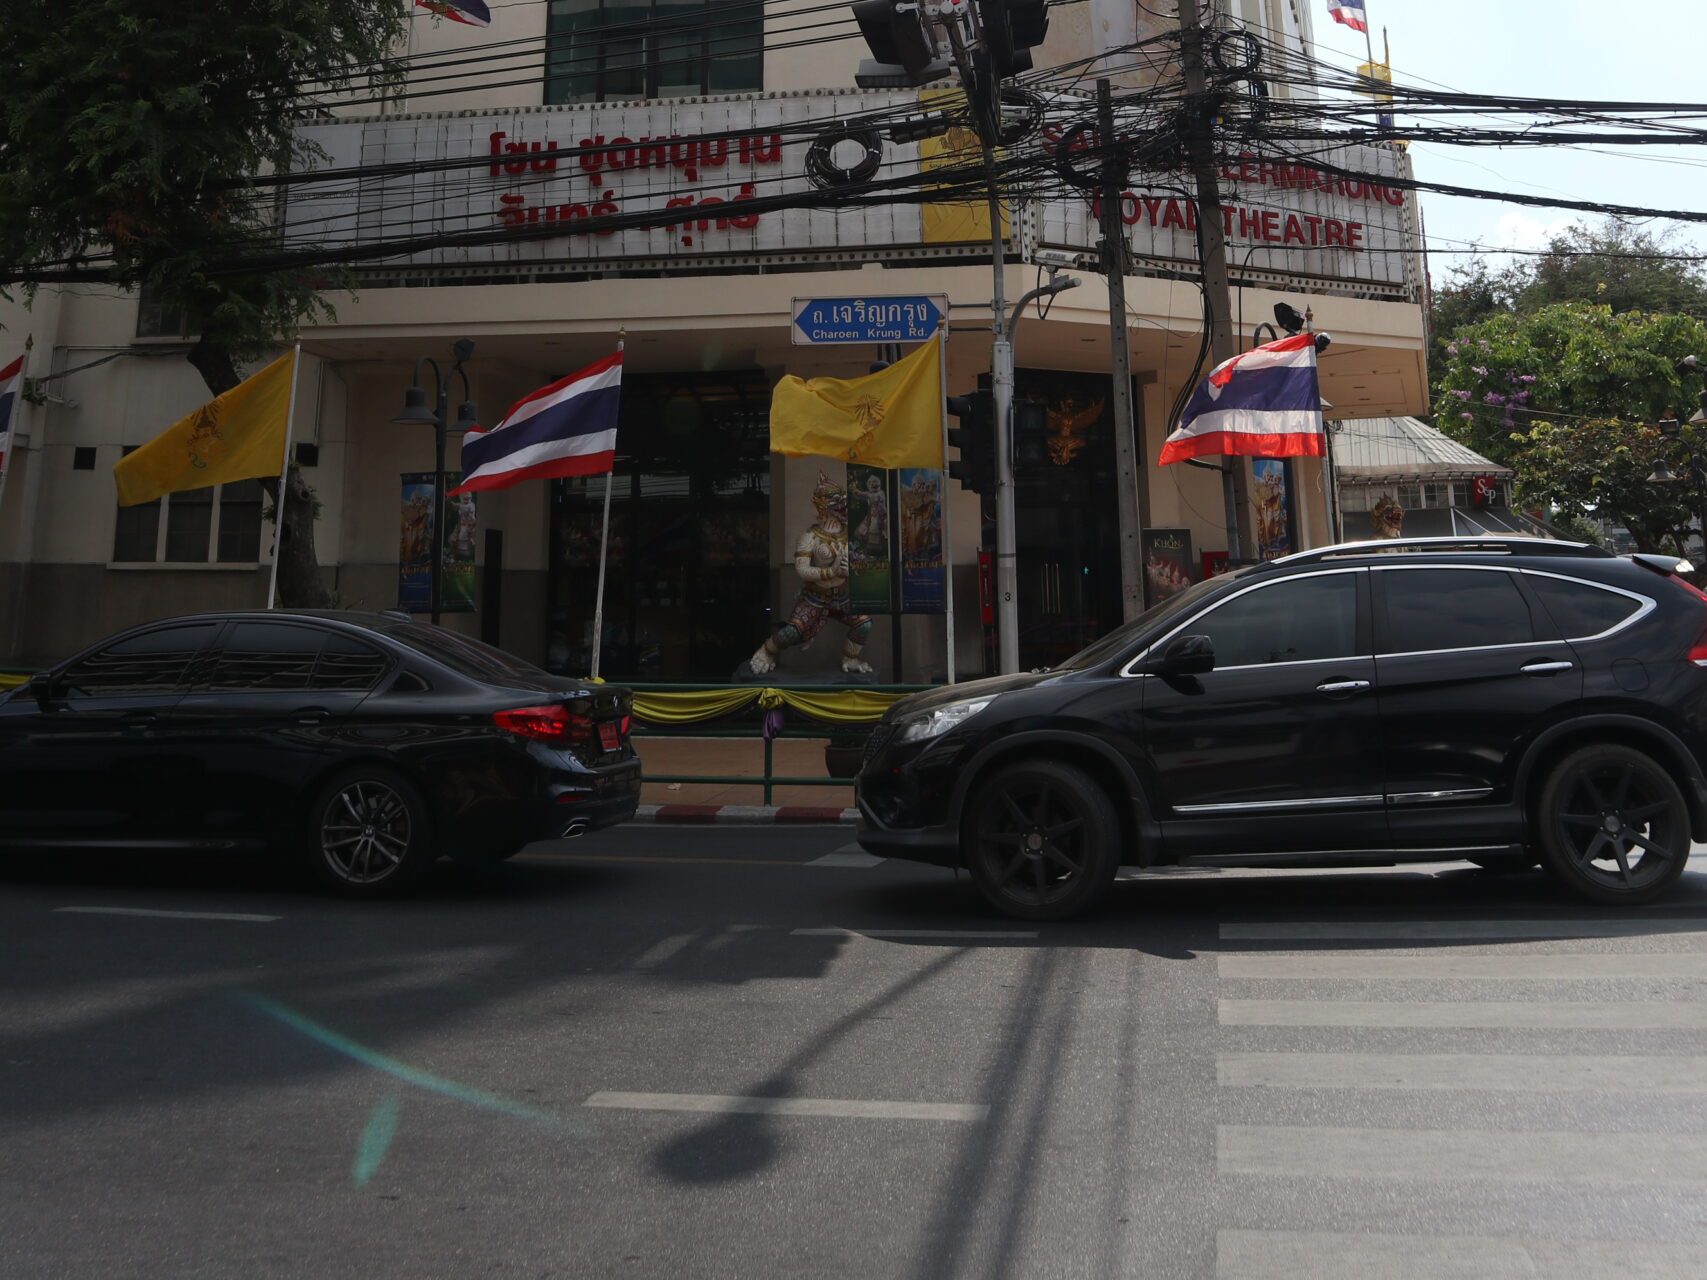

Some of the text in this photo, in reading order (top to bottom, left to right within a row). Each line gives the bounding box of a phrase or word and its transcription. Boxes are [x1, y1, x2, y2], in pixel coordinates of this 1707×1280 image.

[1092, 186, 1364, 253] OYAL THEATRE
[812, 327, 927, 339] Charoen Krung Rd.
[1004, 591, 1011, 602] 3
